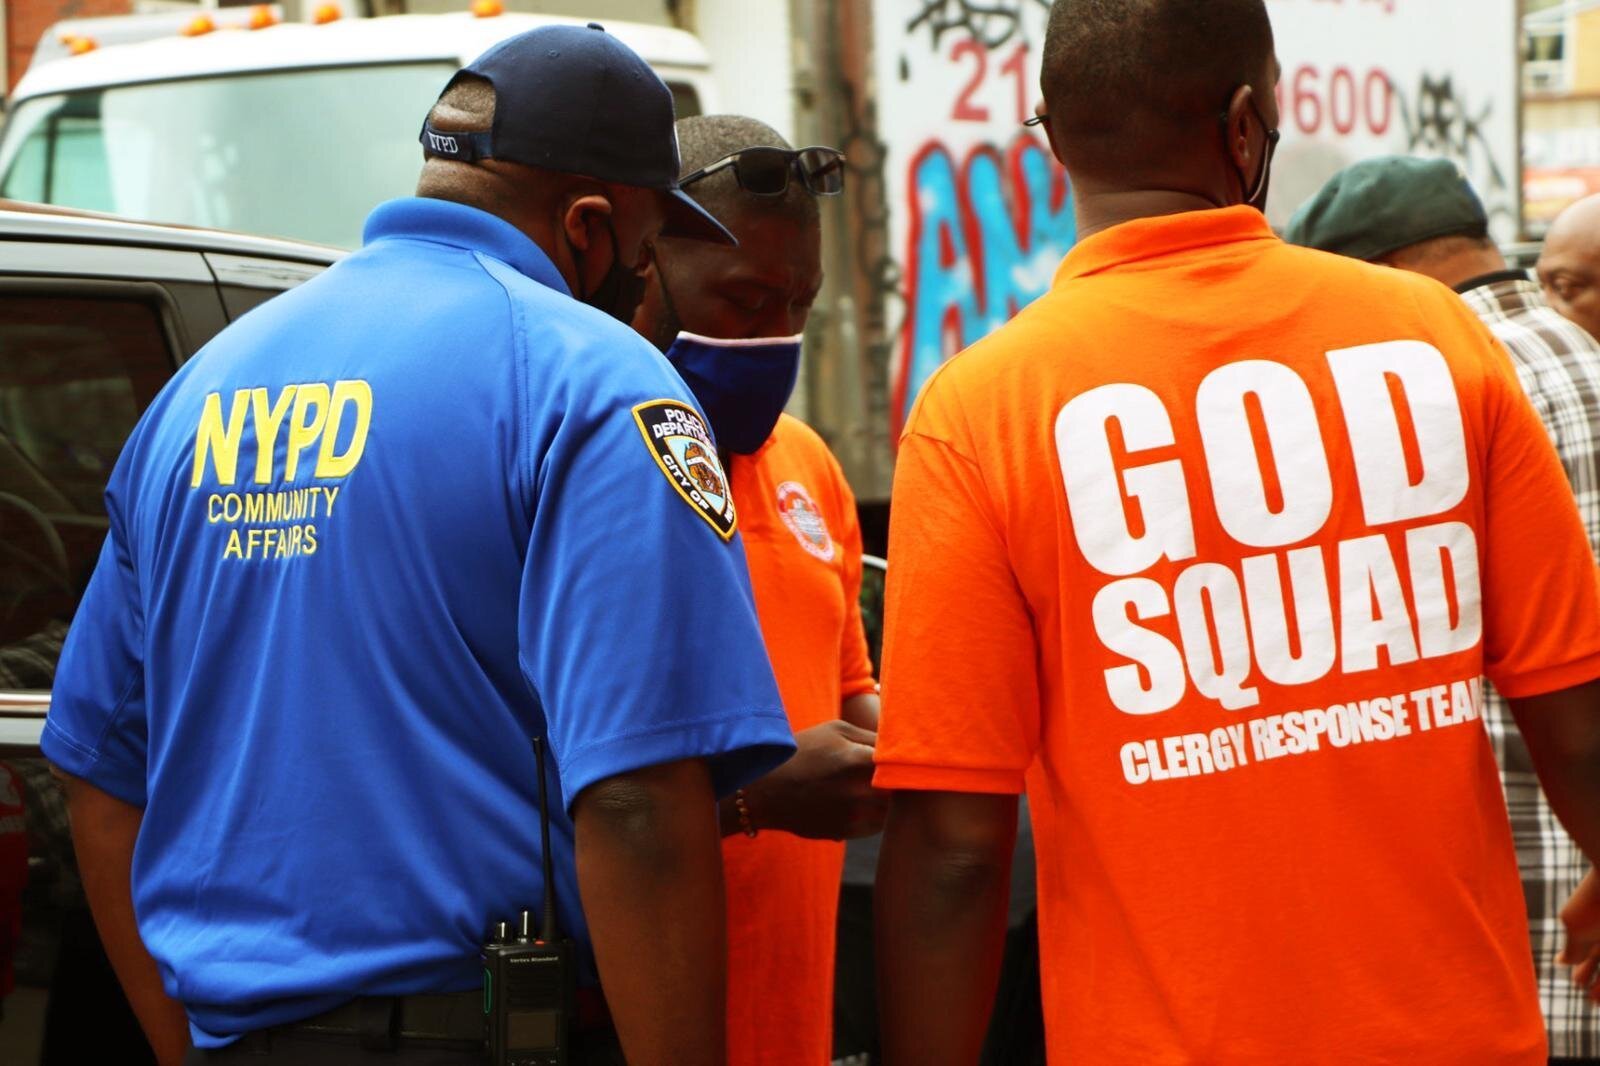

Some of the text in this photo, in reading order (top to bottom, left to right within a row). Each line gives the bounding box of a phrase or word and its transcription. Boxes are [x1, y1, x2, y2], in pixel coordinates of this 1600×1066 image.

[1274, 65, 1393, 135] 600
[427, 131, 459, 154] NYPD
[190, 379, 374, 489] NYPD
[1054, 339, 1470, 577] GOD
[208, 487, 340, 523] COMMUNITY
[662, 454, 710, 510] CITY OF
[222, 524, 318, 560] AFFAIRS
[1091, 521, 1483, 716] SQUAD
[1119, 720, 1249, 786] CLERGY
[1251, 693, 1412, 762] RESPONSE
